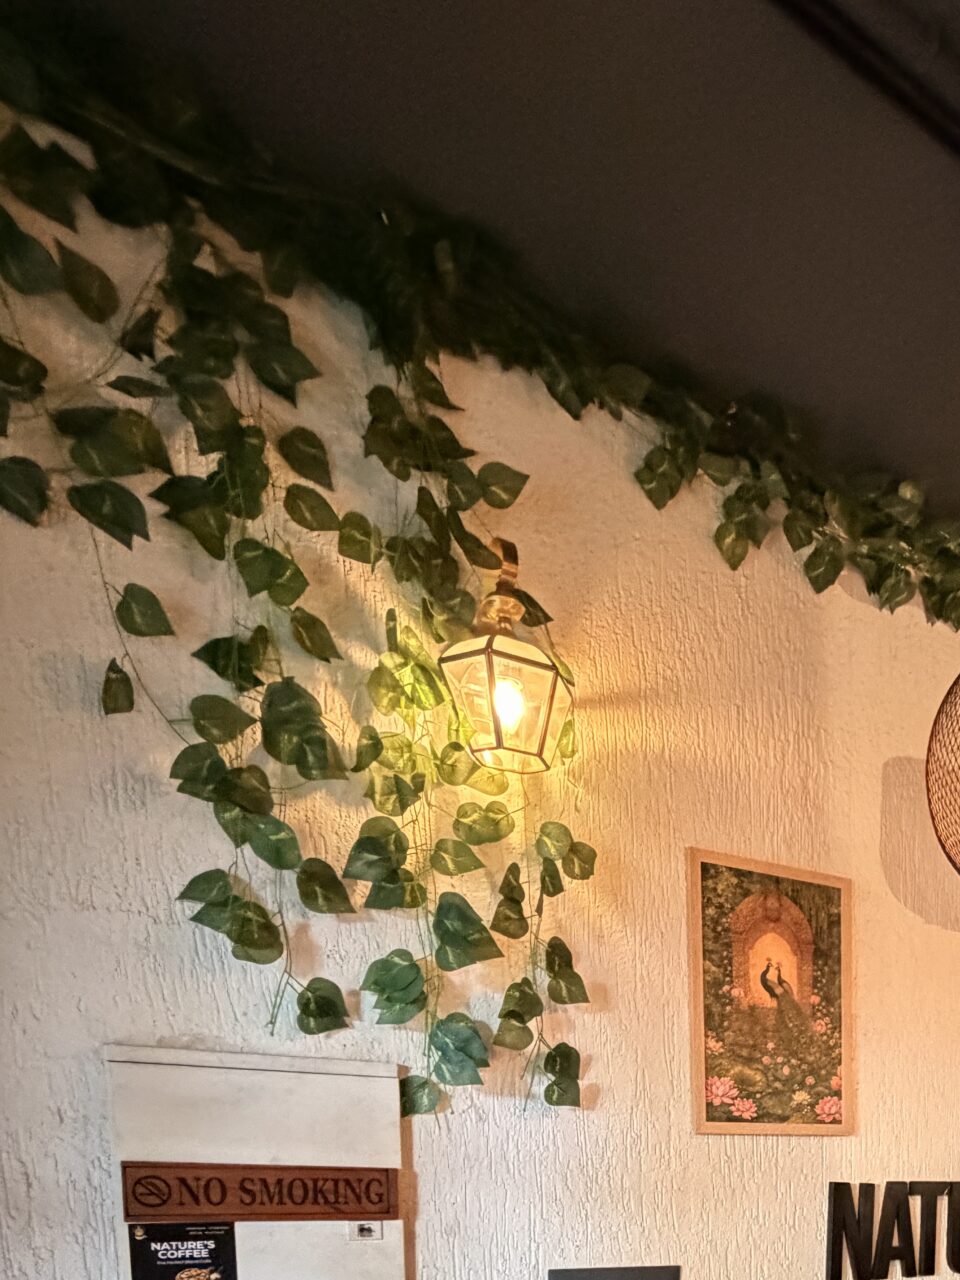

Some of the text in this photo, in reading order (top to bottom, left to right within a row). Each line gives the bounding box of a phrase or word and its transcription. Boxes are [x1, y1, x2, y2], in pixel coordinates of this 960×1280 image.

[176, 1177, 384, 1206] NO SMOKING
[150, 1240, 216, 1251] NATURE'S
[157, 1249, 210, 1259] COFFEE
